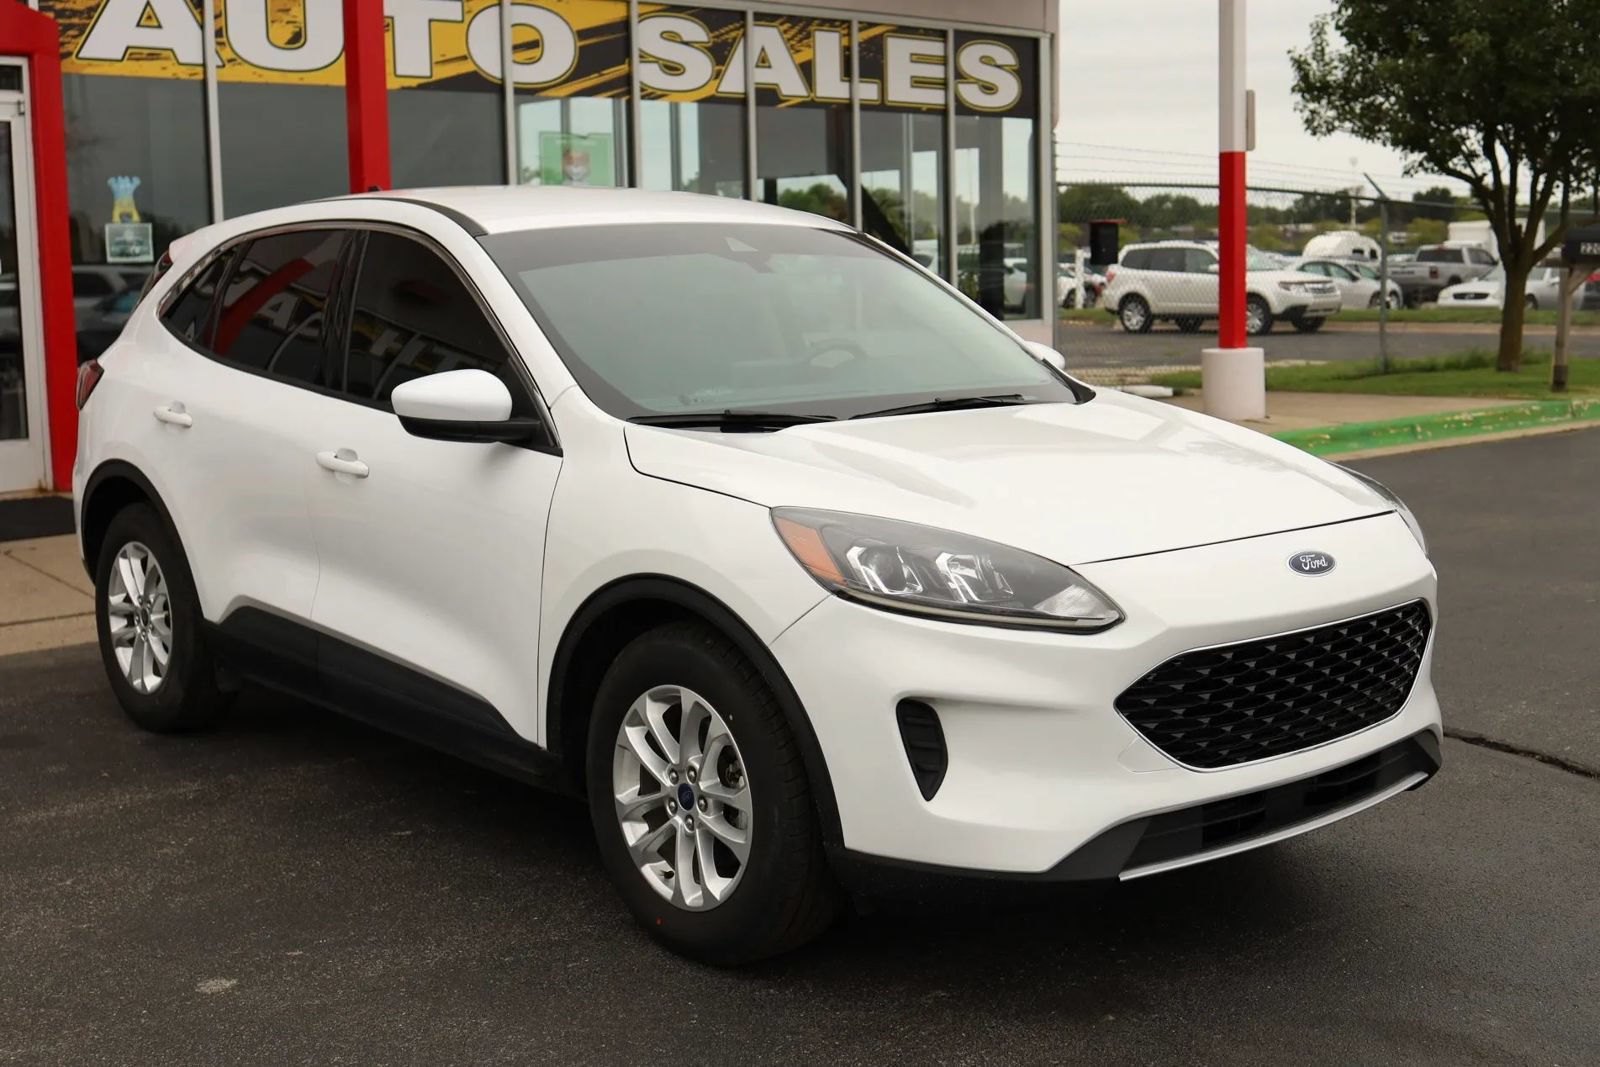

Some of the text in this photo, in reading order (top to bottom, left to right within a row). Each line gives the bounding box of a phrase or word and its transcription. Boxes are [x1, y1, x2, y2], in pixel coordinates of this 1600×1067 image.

[77, 0, 1021, 111] AUTO SALES
[1299, 554, 1328, 570] Ford
